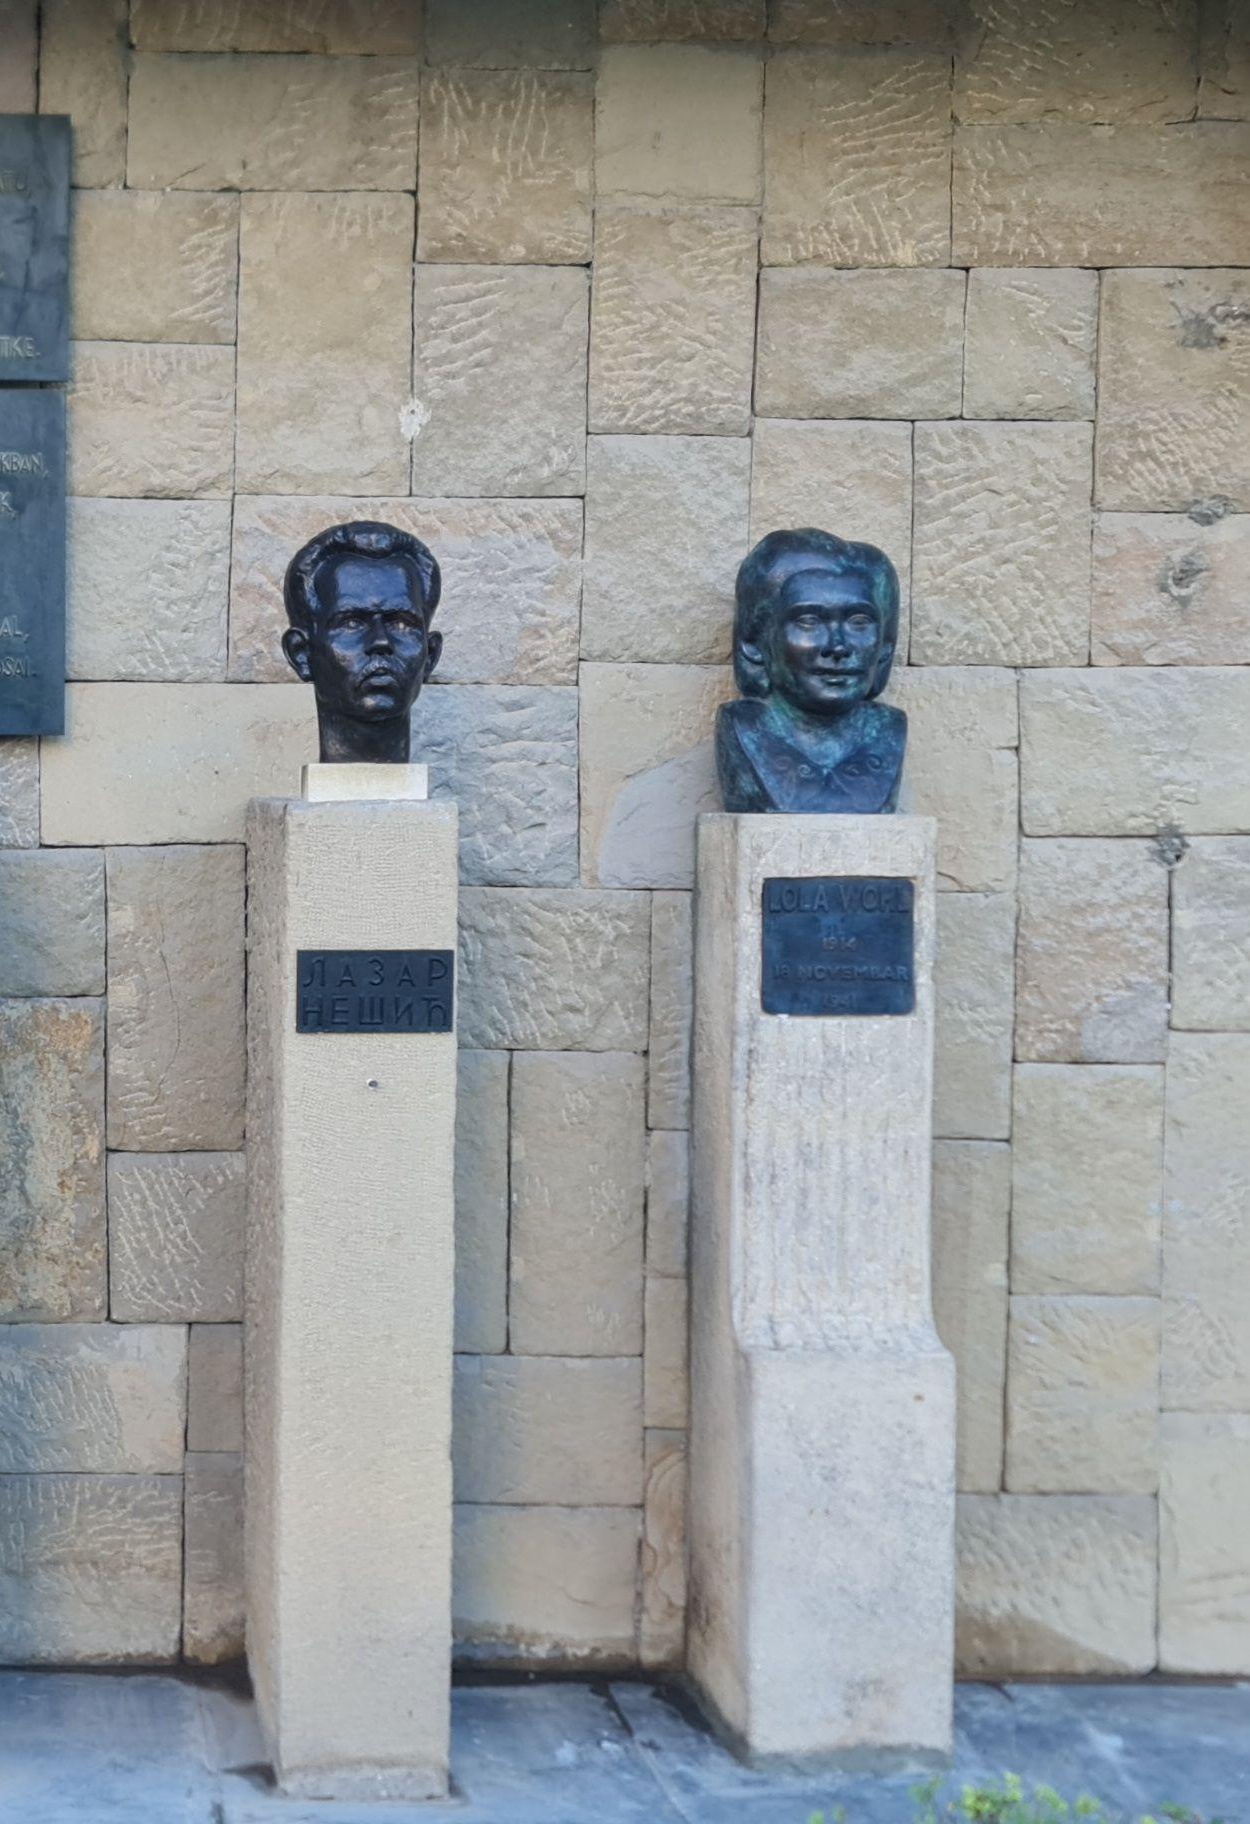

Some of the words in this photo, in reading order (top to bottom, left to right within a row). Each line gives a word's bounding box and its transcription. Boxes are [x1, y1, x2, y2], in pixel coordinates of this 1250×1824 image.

[769, 884, 829, 914] LOLA
[302, 956, 448, 988] ЛАЗАР
[302, 994, 448, 1027] НЕШИЋ
